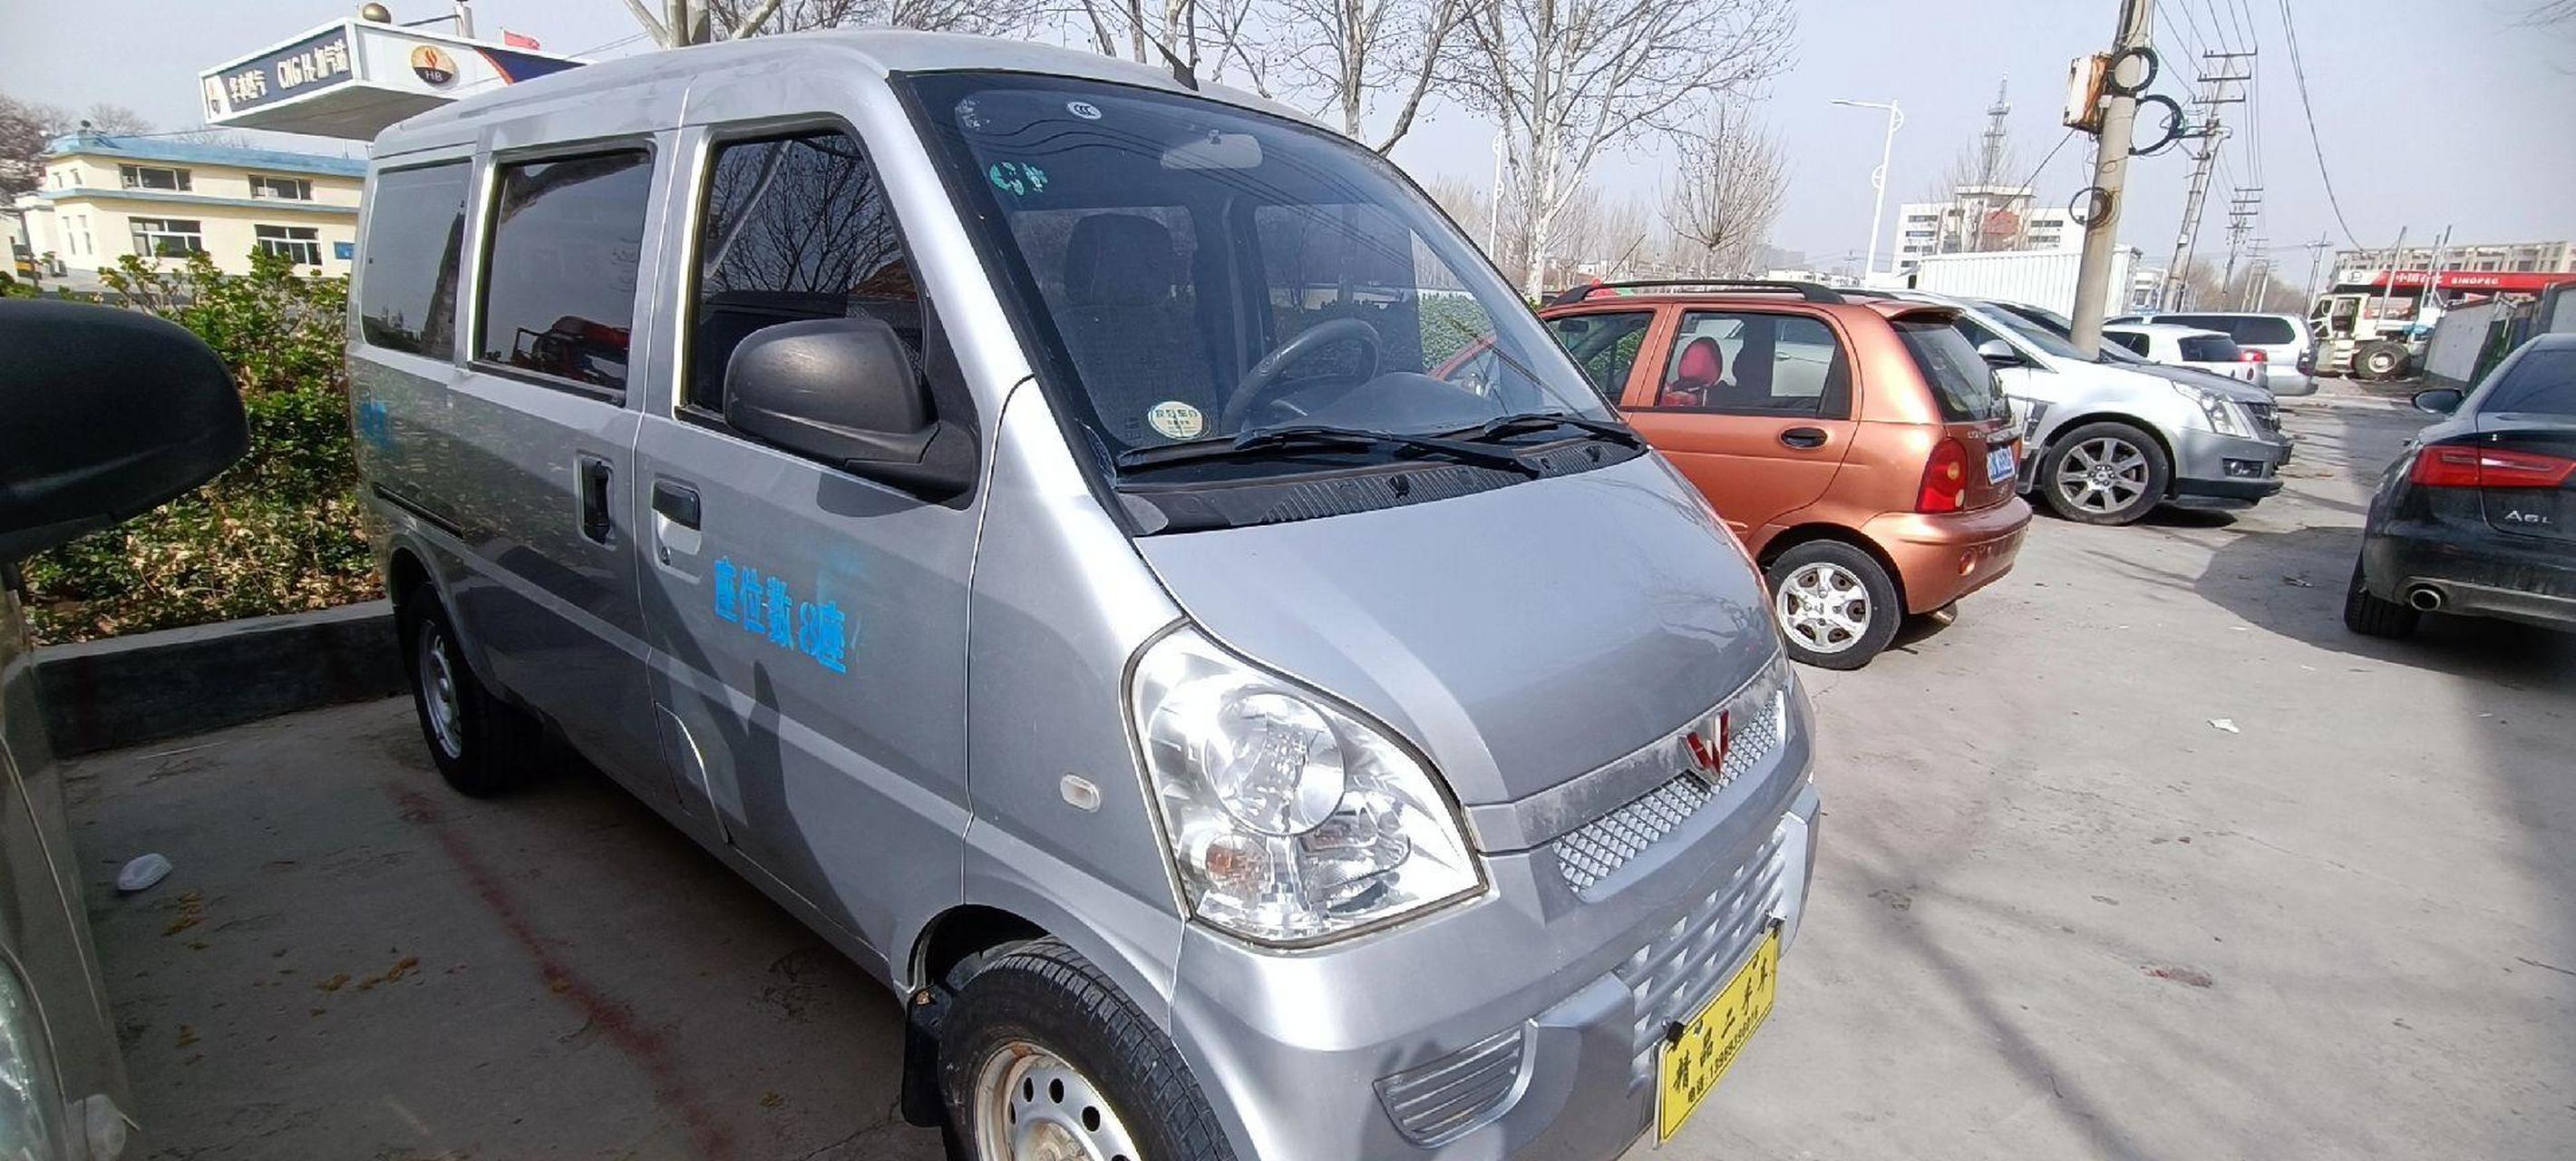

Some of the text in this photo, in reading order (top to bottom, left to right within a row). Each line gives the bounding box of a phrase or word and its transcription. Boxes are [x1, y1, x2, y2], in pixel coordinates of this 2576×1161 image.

[424, 70, 443, 82] HB
[2451, 276, 2500, 285] SINOPEC
[2504, 510, 2552, 523] A6L
[1673, 957, 1768, 1094] 精品二手车
